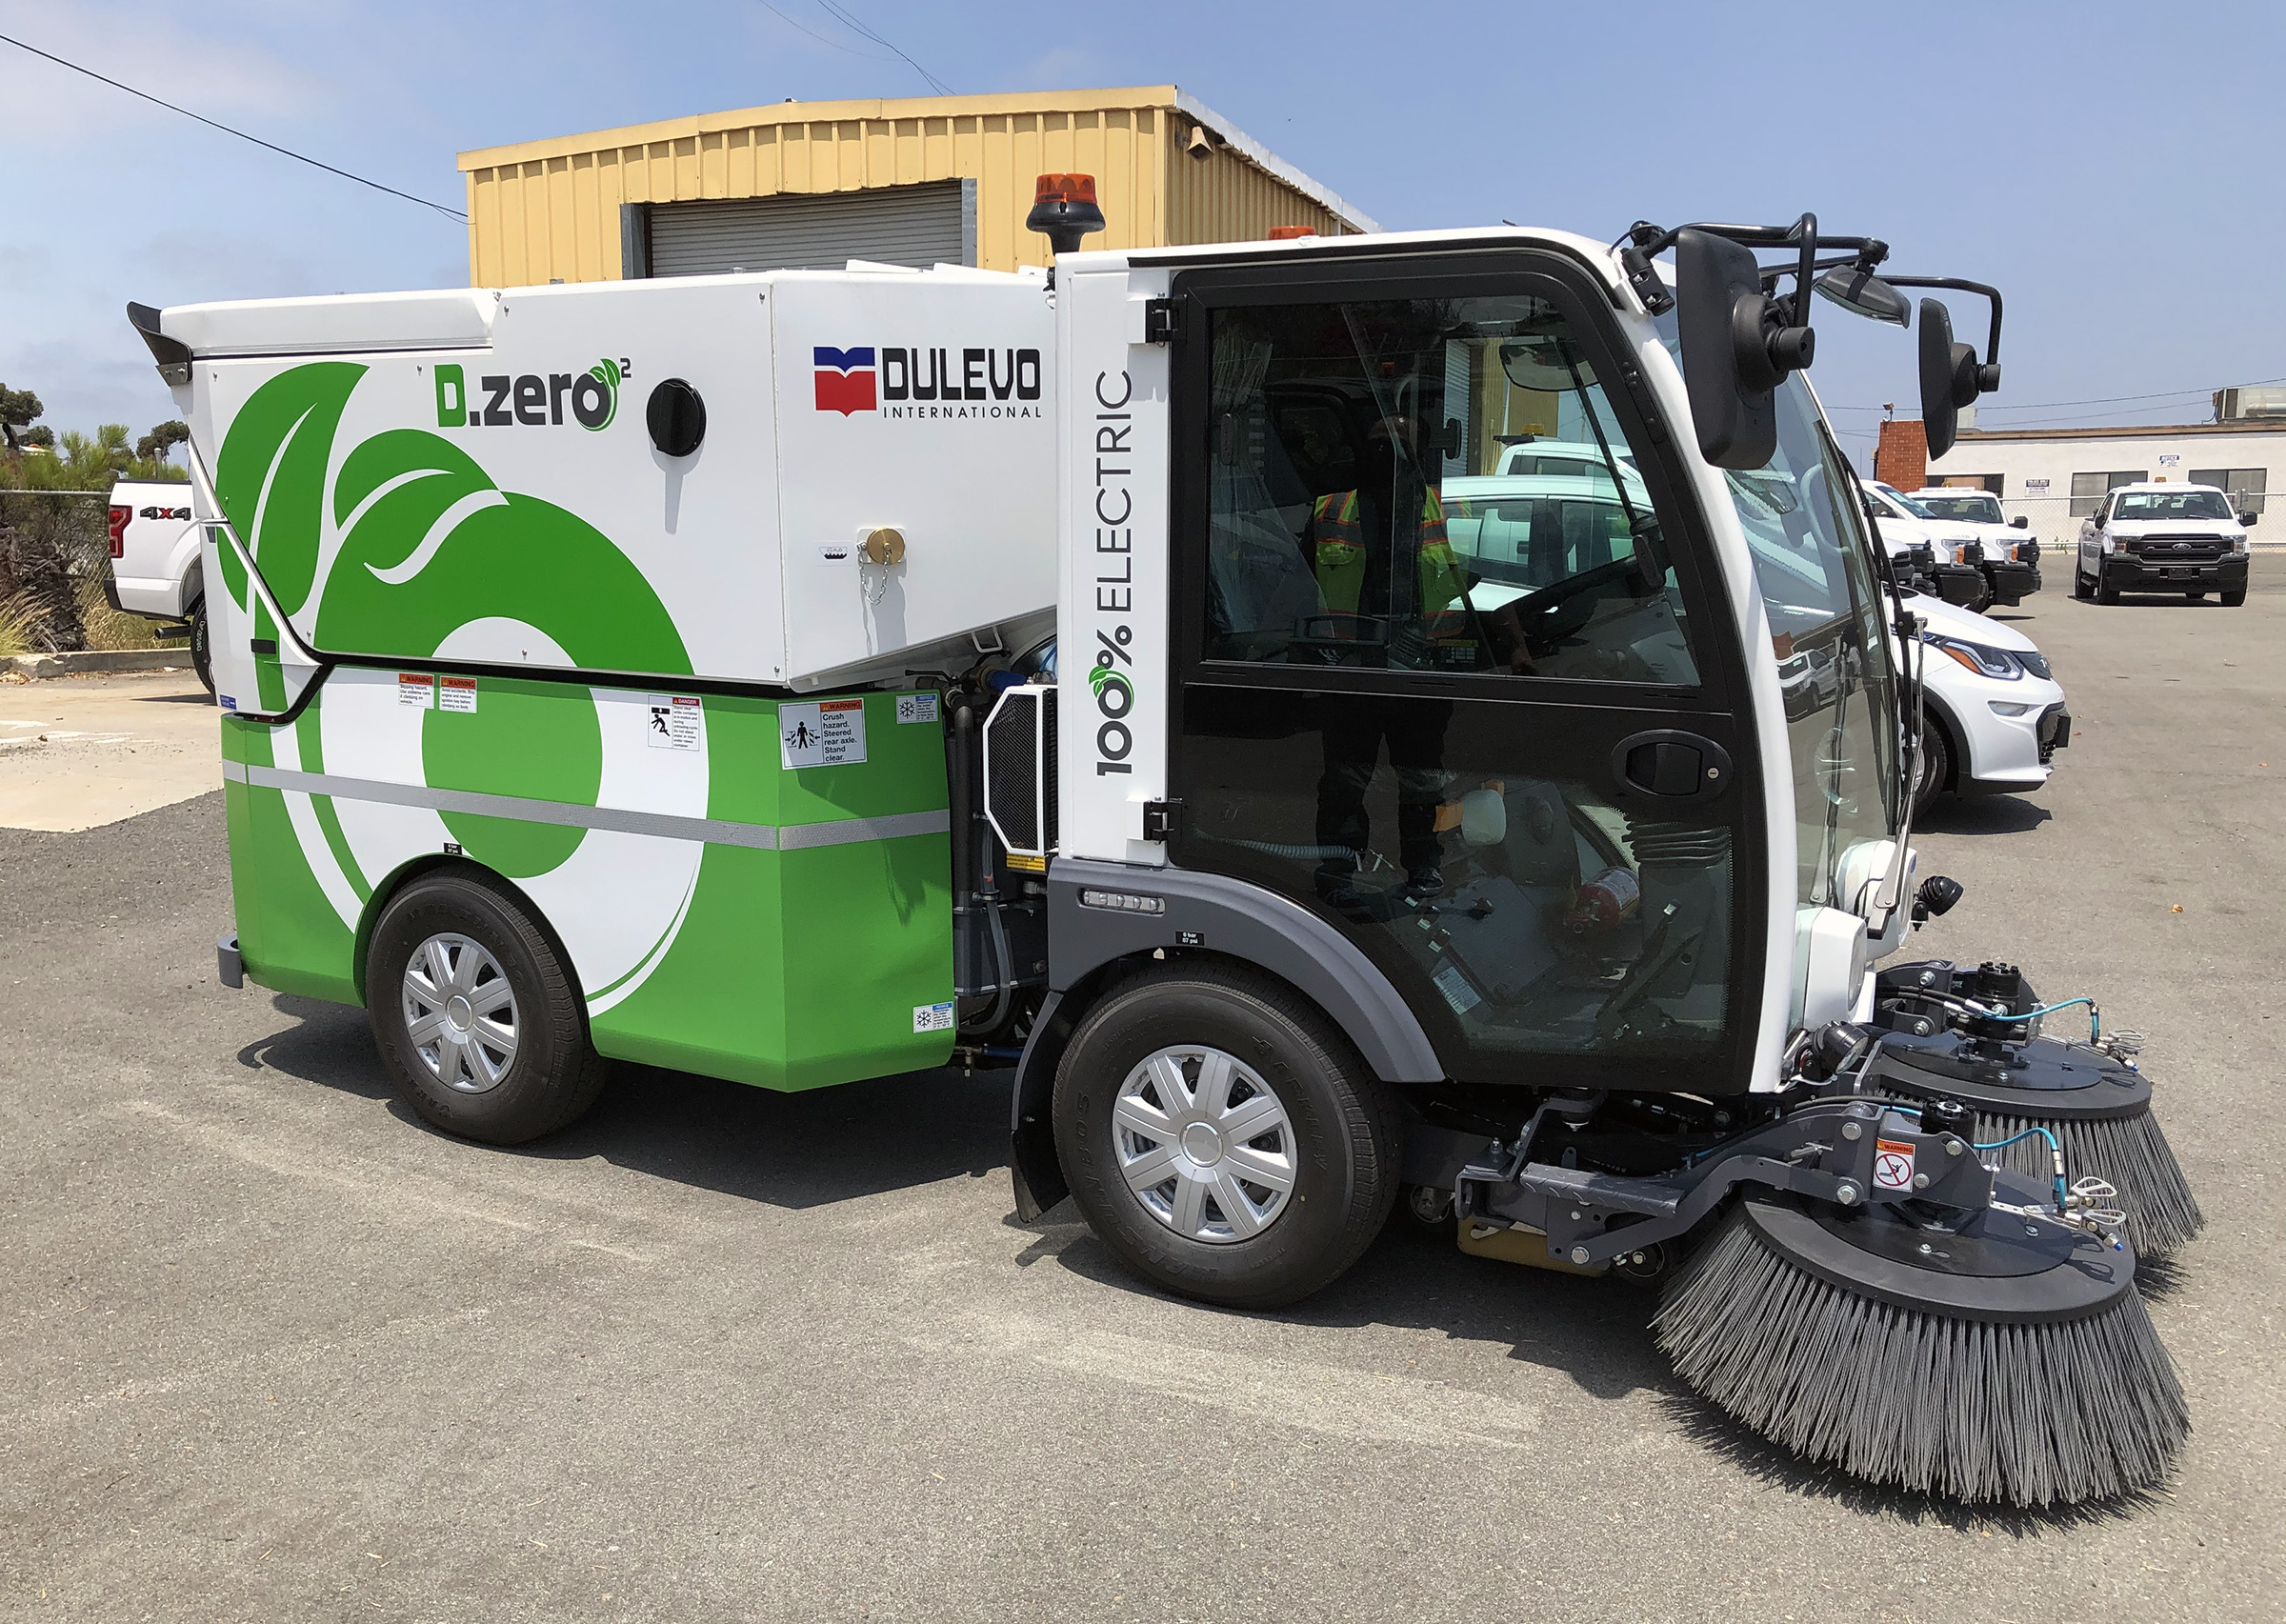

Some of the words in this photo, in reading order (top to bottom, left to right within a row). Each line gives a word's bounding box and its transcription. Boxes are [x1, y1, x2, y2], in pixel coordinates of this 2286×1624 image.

[882, 348, 1040, 400] DULEVO
[884, 407, 1041, 418] INTERNATIONAL
[1095, 370, 1133, 612] ELECTRIC
[407, 675, 432, 684] WARNING
[448, 679, 474, 688] WARNING
[1093, 625, 1133, 776] 100%
[830, 701, 861, 710] WARNING
[822, 712, 845, 721] Crush
[823, 721, 850, 730] hazard.
[823, 729, 852, 737] Steered
[824, 745, 846, 753] Stand
[1884, 1144, 1913, 1153] WARNING
